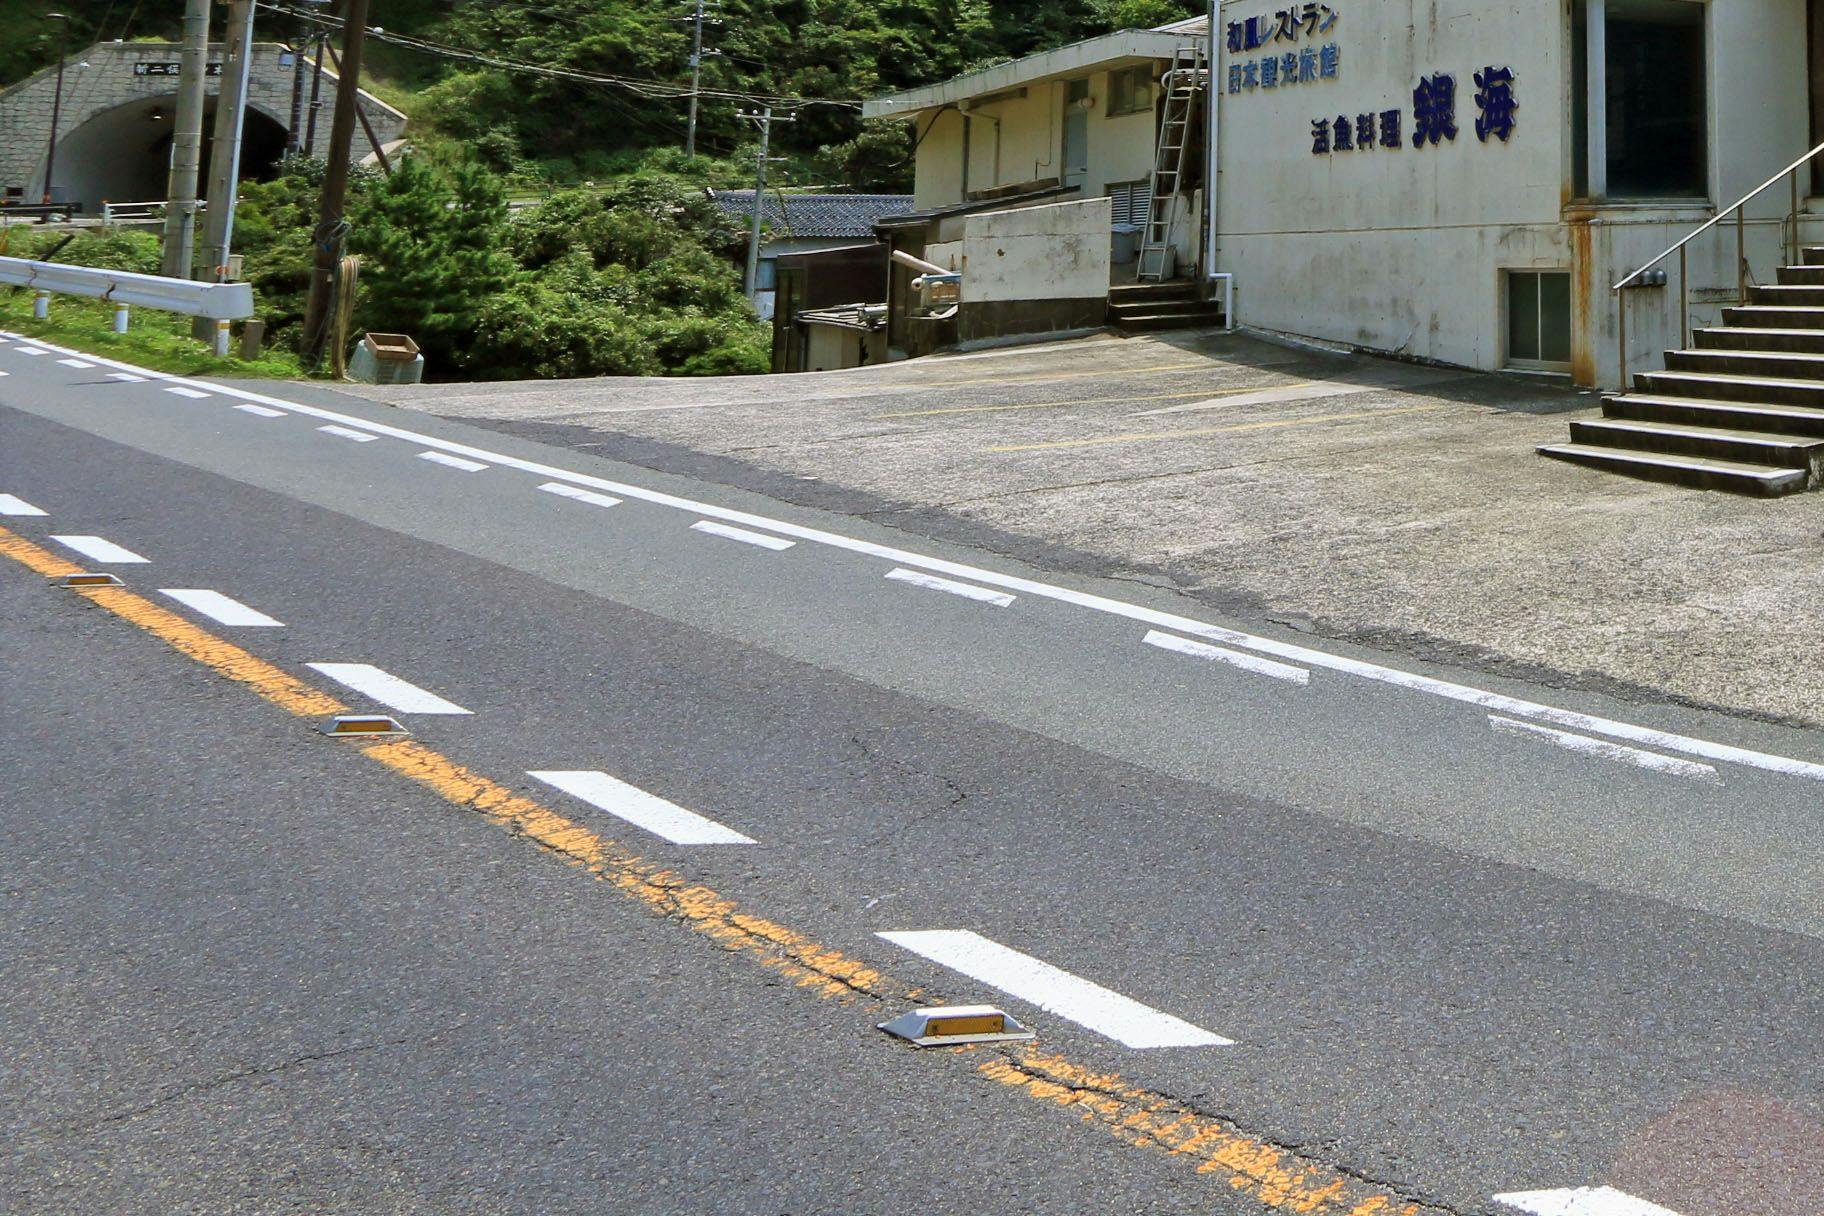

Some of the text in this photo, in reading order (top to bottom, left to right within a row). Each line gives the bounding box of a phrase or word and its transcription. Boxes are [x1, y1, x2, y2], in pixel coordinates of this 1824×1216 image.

[1226, 2, 1339, 54] 和風レストラン
[1228, 42, 1339, 94] 日本観光旅館
[1311, 108, 1402, 155] 活魚料理
